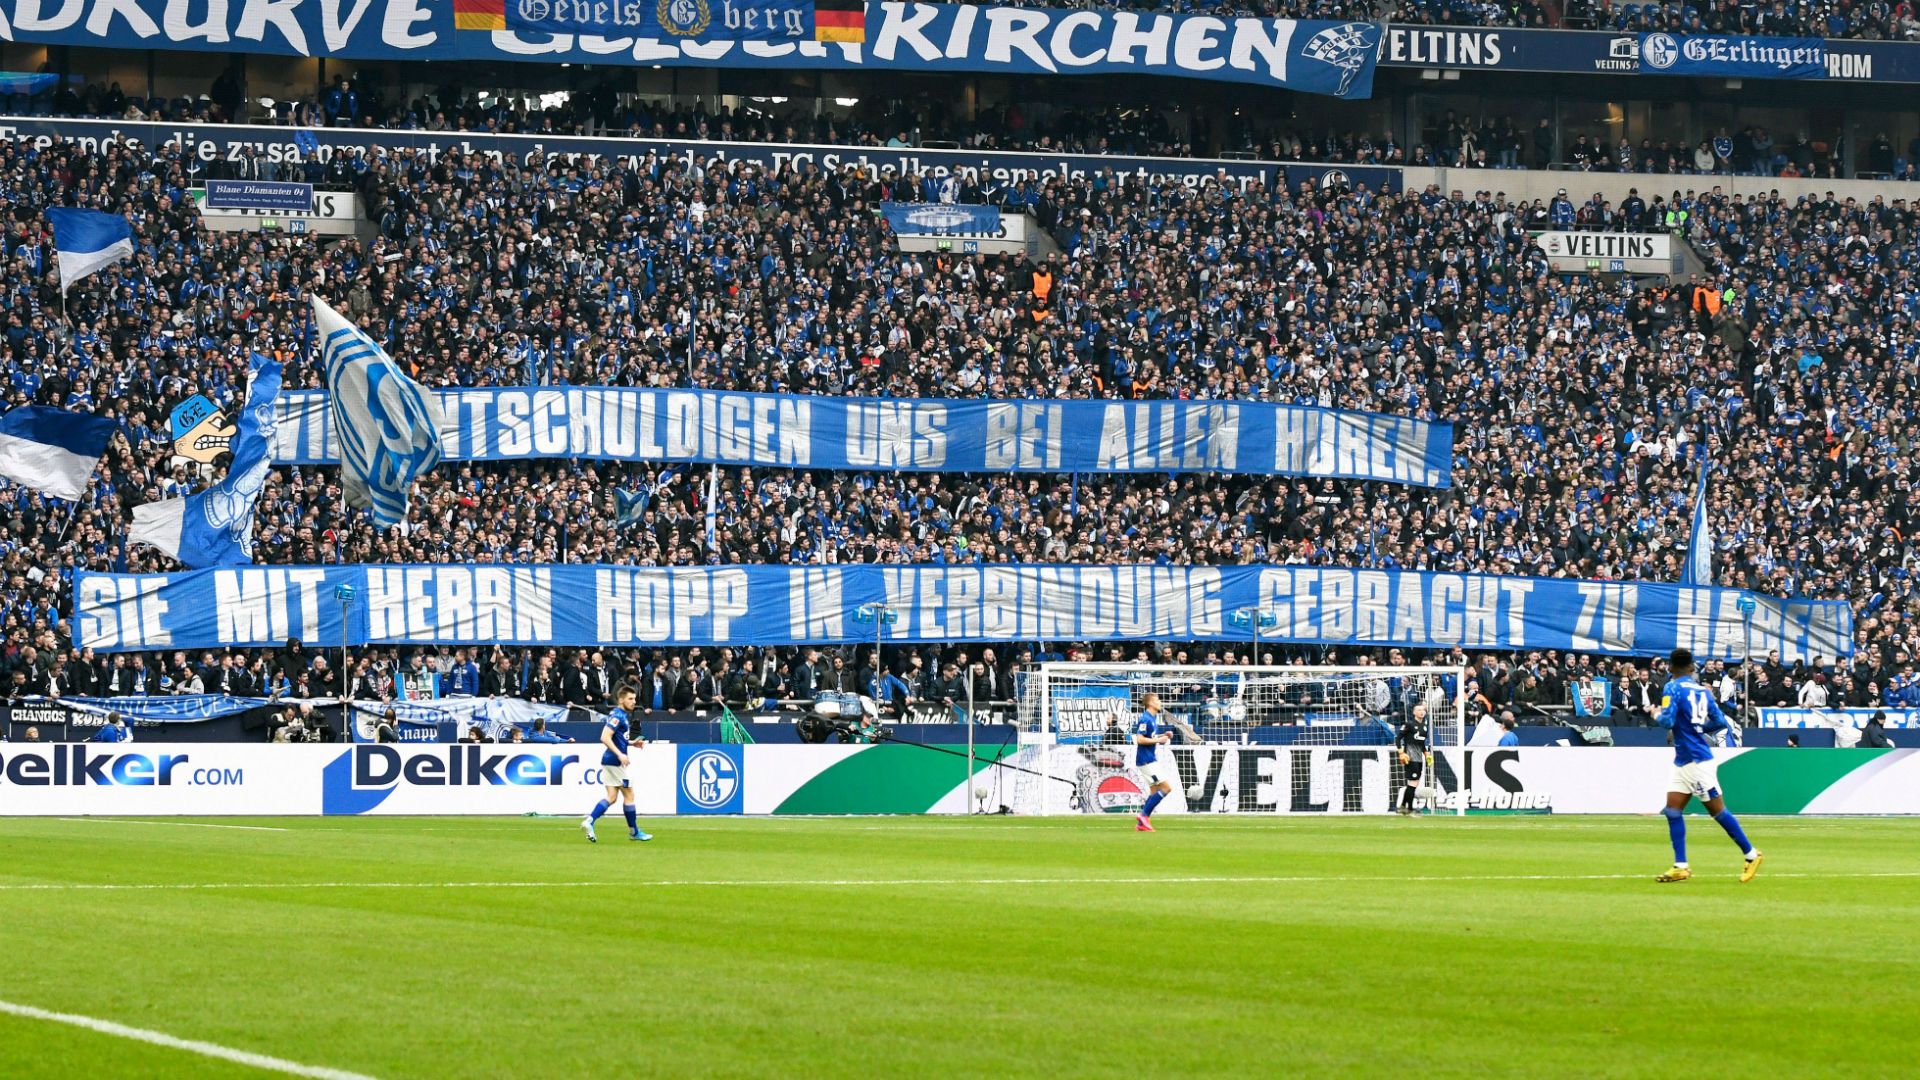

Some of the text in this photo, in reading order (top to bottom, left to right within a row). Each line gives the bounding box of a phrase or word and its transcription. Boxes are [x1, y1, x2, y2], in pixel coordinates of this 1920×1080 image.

[723, 0, 804, 36] berg
[1390, 29, 1501, 65] ELTINS
[1683, 38, 1821, 69] GErlingen
[1595, 59, 1631, 70] VELTINS
[1824, 54, 1872, 79] ROM
[163, 132, 217, 161] die
[243, 186, 291, 195] Diamanten
[294, 188, 304, 196] 04
[964, 242, 976, 252] N4
[1566, 235, 1654, 258] VELTINS
[1611, 261, 1623, 271] N5
[178, 402, 207, 428] GE
[438, 390, 811, 465] NTSCHULDIGEN
[846, 402, 948, 468] UNS
[984, 403, 1062, 469] BEI
[1097, 404, 1239, 470] ALLEN
[79, 576, 174, 648] SIE
[214, 568, 325, 643] MIT
[367, 567, 552, 640] HERRN
[596, 568, 749, 642] HOPP
[789, 567, 844, 640] IN
[883, 566, 1223, 639] VERBINDUNG
[1258, 568, 1534, 646] GEBRACHT
[1571, 583, 1638, 651] ZU
[11, 709, 66, 722] CHANGOS
[1687, 690, 1709, 725] 14
[0, 745, 243, 786] elker.COM
[1173, 749, 1524, 813] VELTINS
